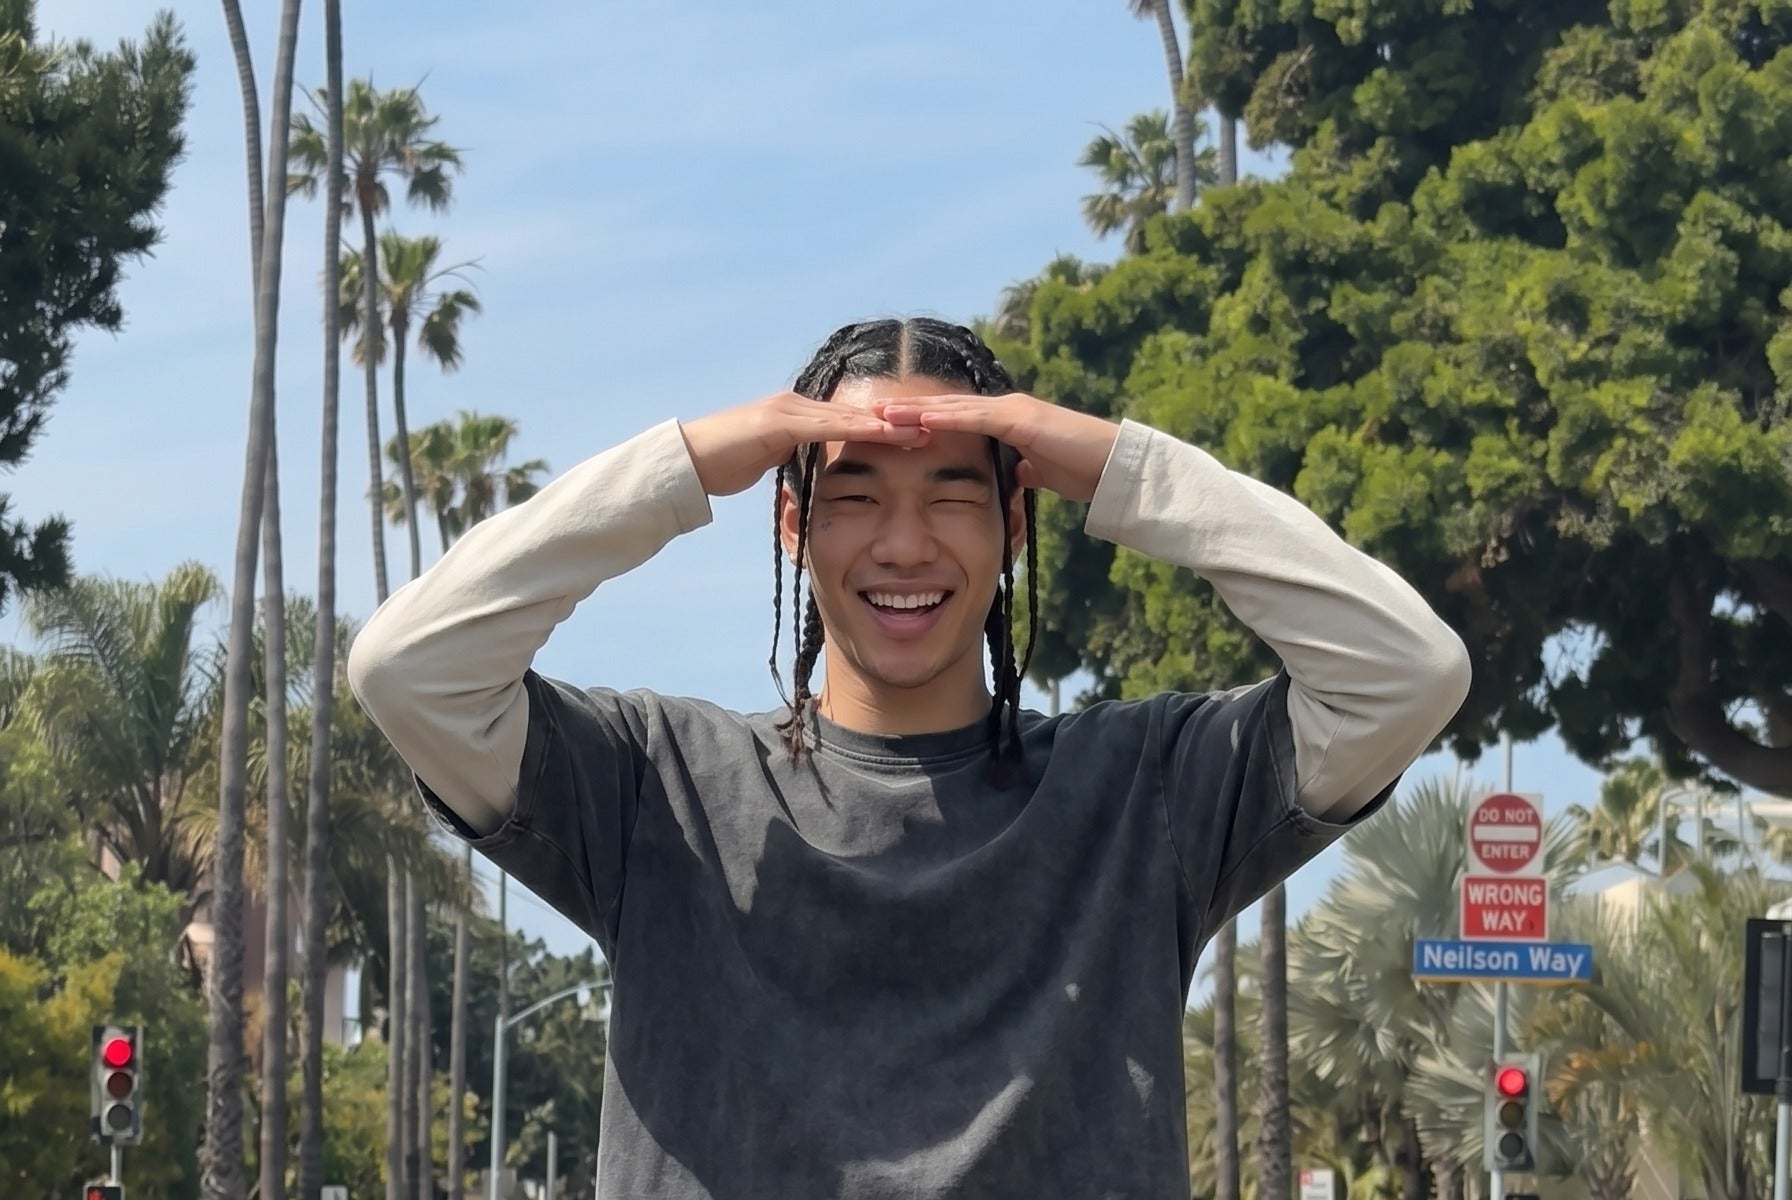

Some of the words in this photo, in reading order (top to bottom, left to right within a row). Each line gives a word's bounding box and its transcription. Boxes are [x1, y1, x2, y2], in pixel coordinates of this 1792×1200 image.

[1478, 808, 1500, 823] DO
[1505, 808, 1534, 823] NOT
[1481, 844, 1530, 859] ENTER
[1467, 884, 1543, 906] WRONG
[1481, 910, 1527, 931] WAY
[1423, 944, 1519, 970] Neilson
[1528, 946, 1584, 979] Way
